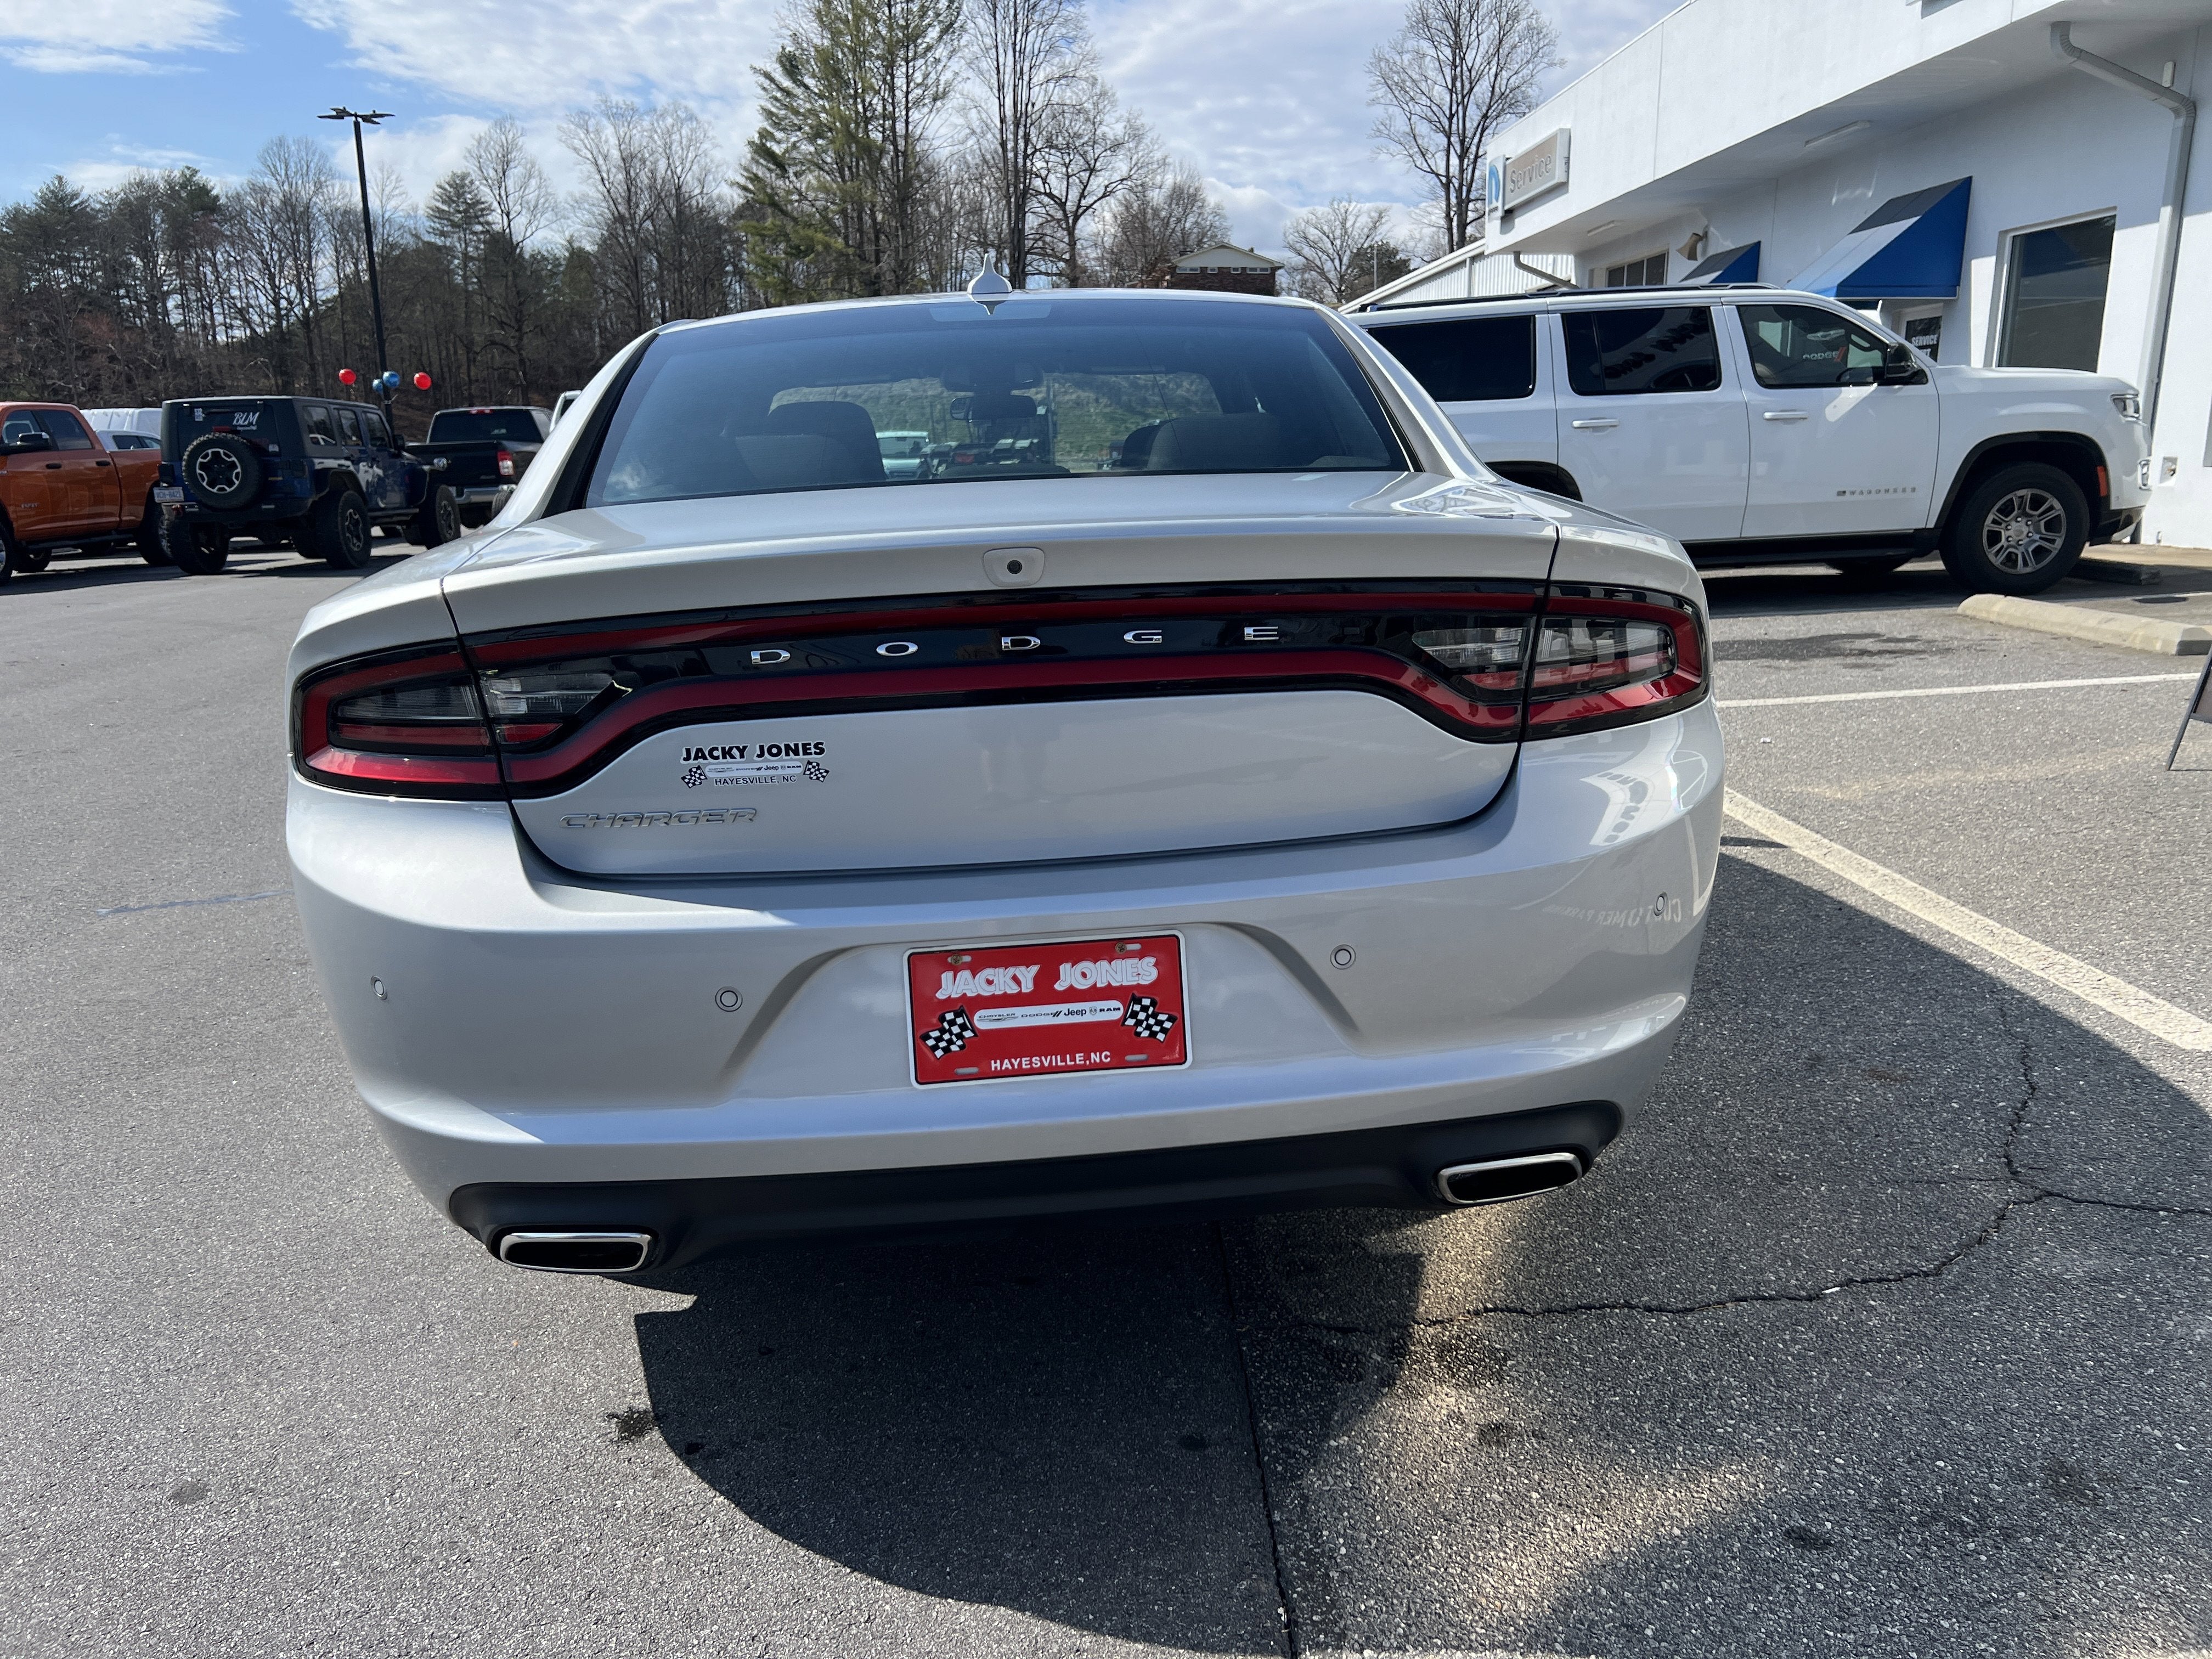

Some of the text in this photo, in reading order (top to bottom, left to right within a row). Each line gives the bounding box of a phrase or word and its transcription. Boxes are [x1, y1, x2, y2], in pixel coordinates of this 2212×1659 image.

[1509, 154, 1552, 193] Service
[1911, 334, 1938, 346] SERVICE
[233, 411, 260, 425] BLM
[751, 626, 1279, 665] DODGE
[681, 741, 826, 763] JACKY JONES
[714, 775, 797, 786] HAYESVILLE, NC
[559, 807, 757, 828] CHARGER
[935, 956, 1158, 999] JACKY JONES
[1064, 1008, 1087, 1017] Jeep
